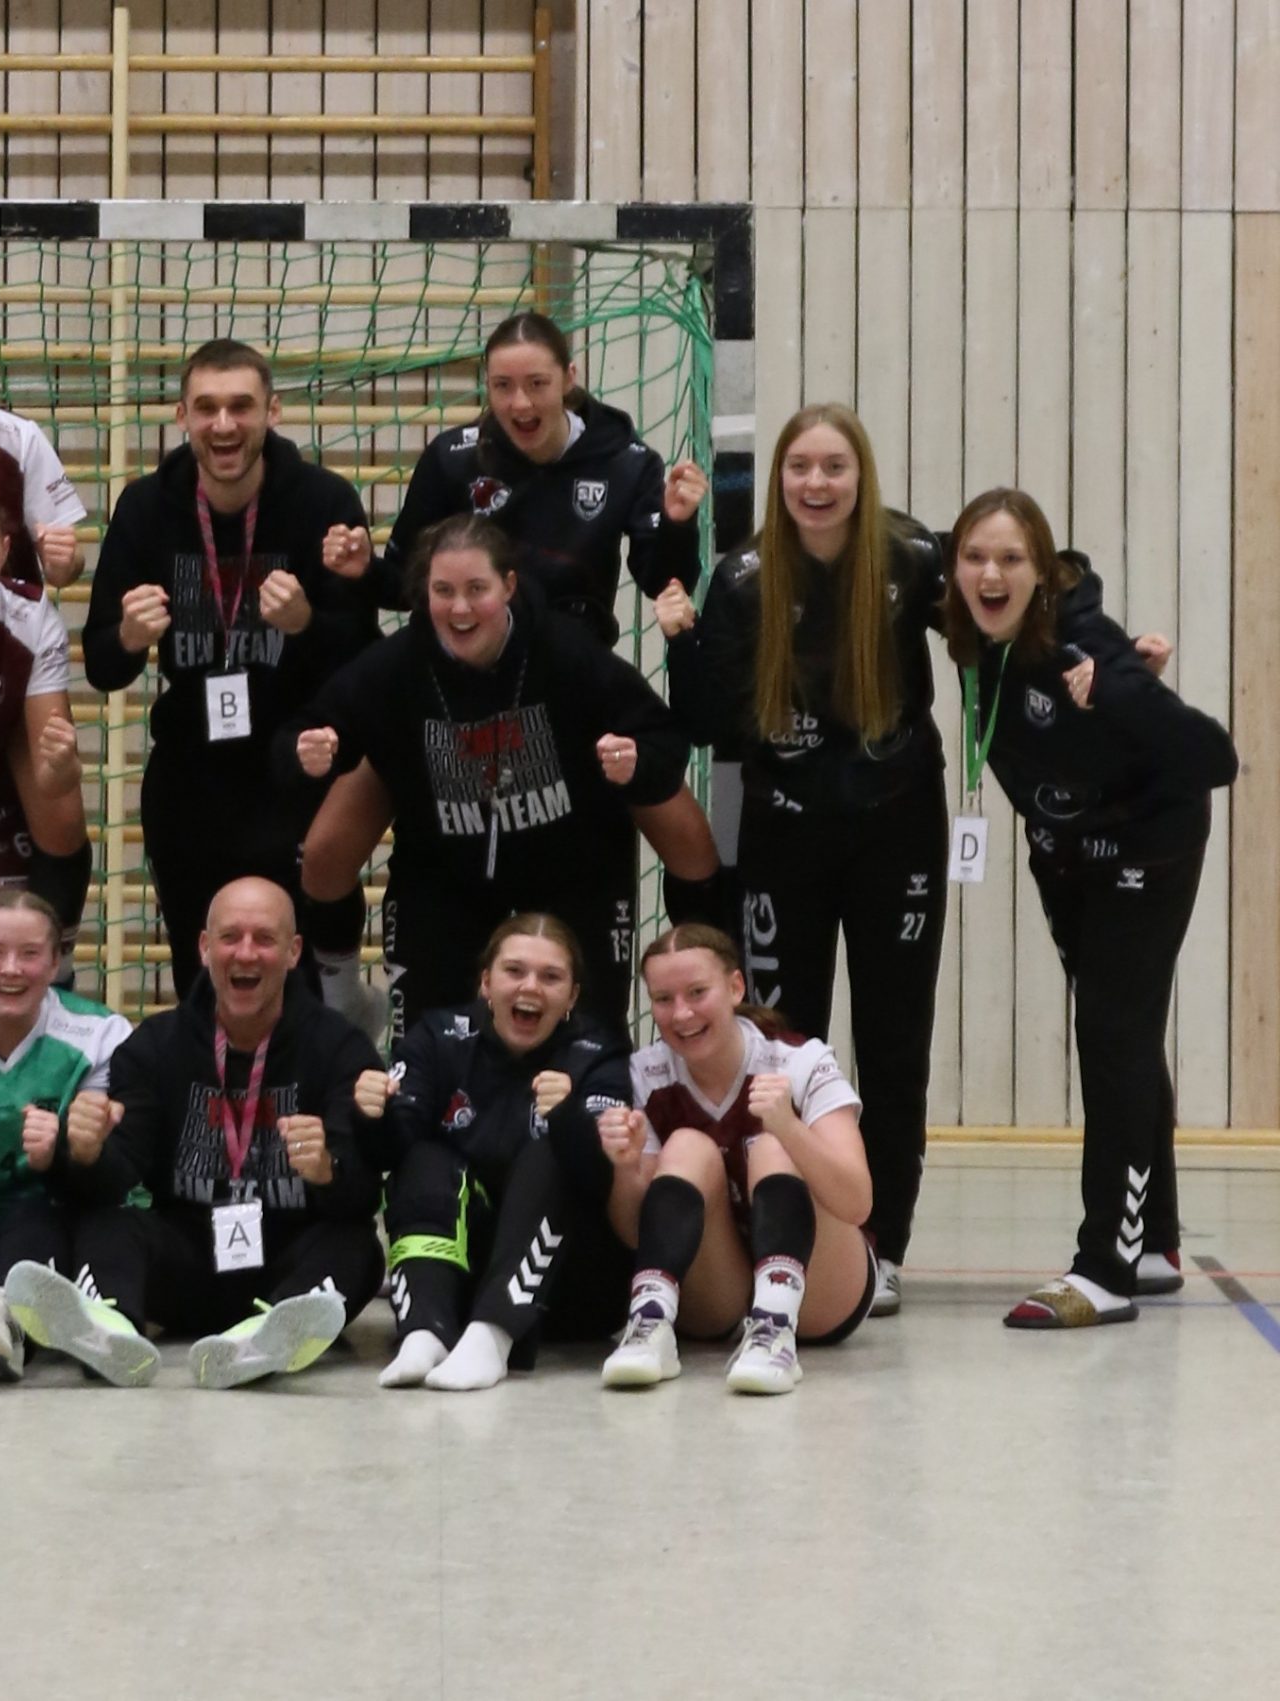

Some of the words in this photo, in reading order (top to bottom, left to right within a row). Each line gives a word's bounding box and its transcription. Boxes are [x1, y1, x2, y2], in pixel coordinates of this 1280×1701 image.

[220, 690, 238, 719] B
[436, 799, 486, 836] EIN
[497, 780, 573, 834] TEAM
[961, 833, 979, 862] D
[900, 911, 926, 942] 27
[227, 1220, 251, 1250] A
